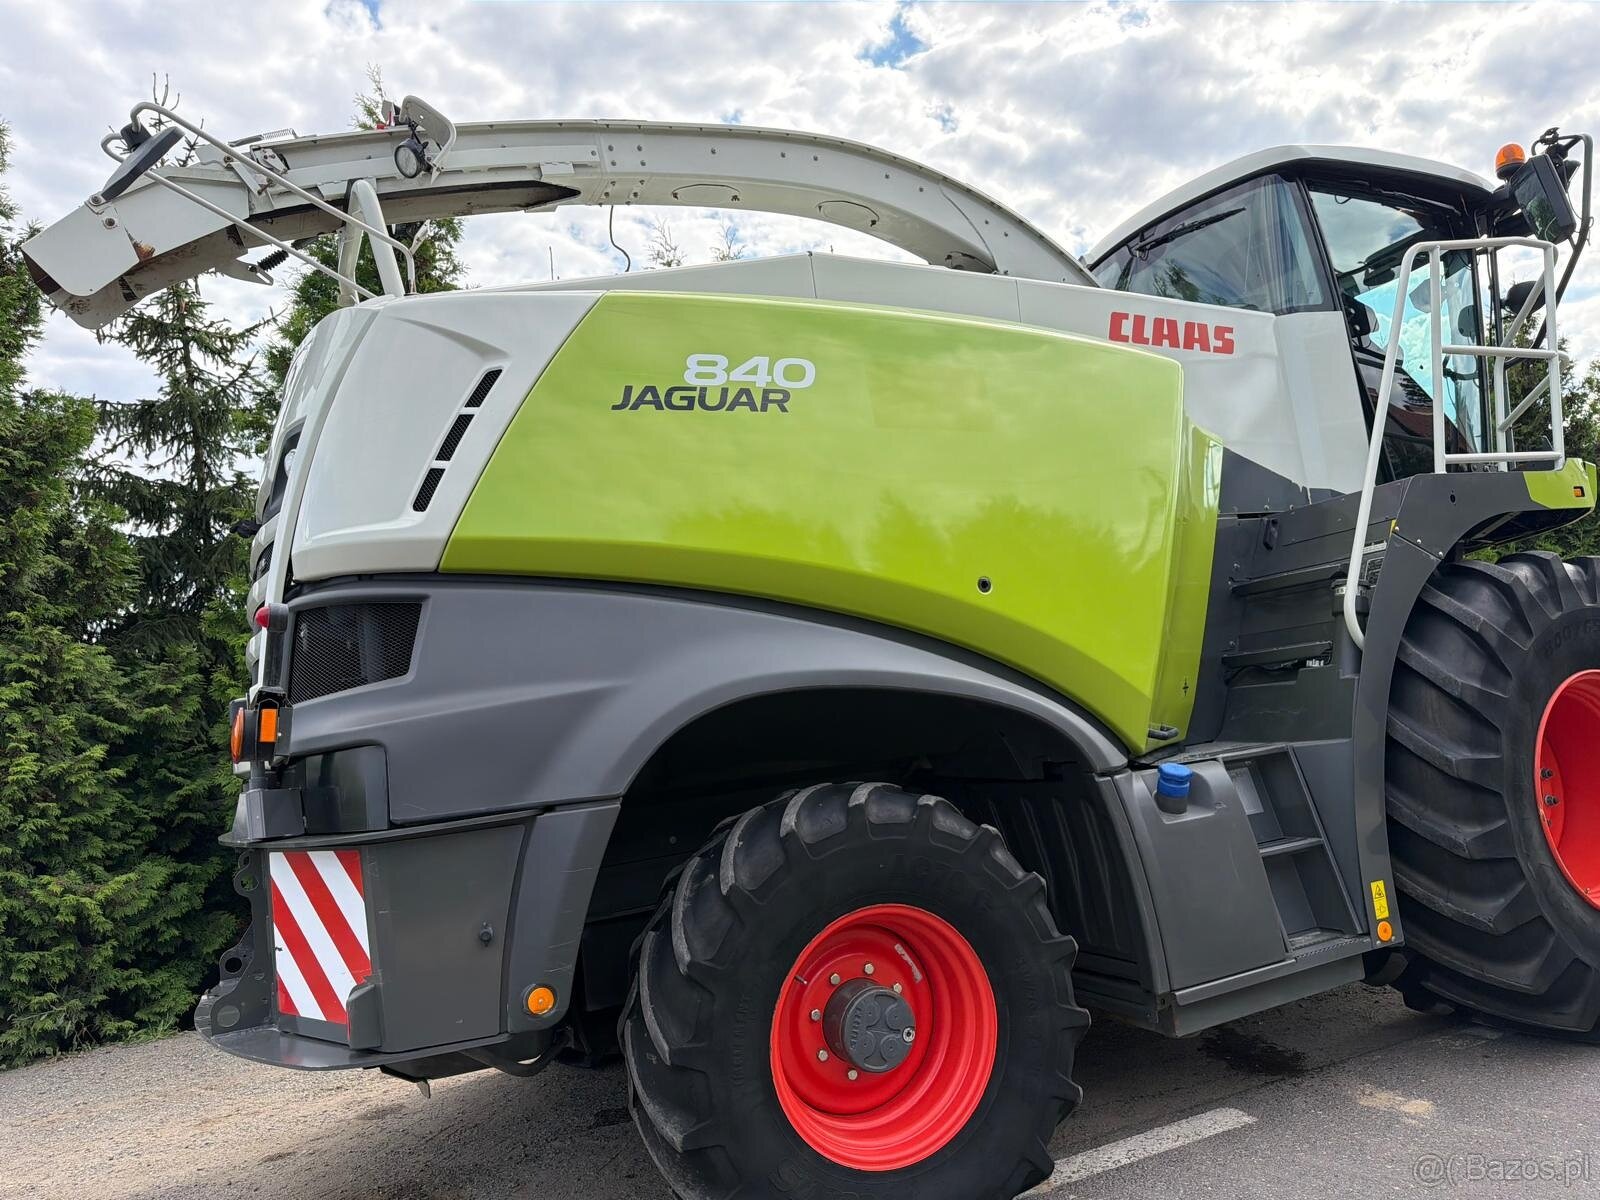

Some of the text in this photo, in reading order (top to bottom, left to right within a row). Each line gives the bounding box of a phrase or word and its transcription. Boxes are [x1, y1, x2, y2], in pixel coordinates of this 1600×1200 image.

[1108, 311, 1235, 355] CLAAS
[683, 353, 816, 389] 840
[611, 385, 791, 413] JAGUAR
